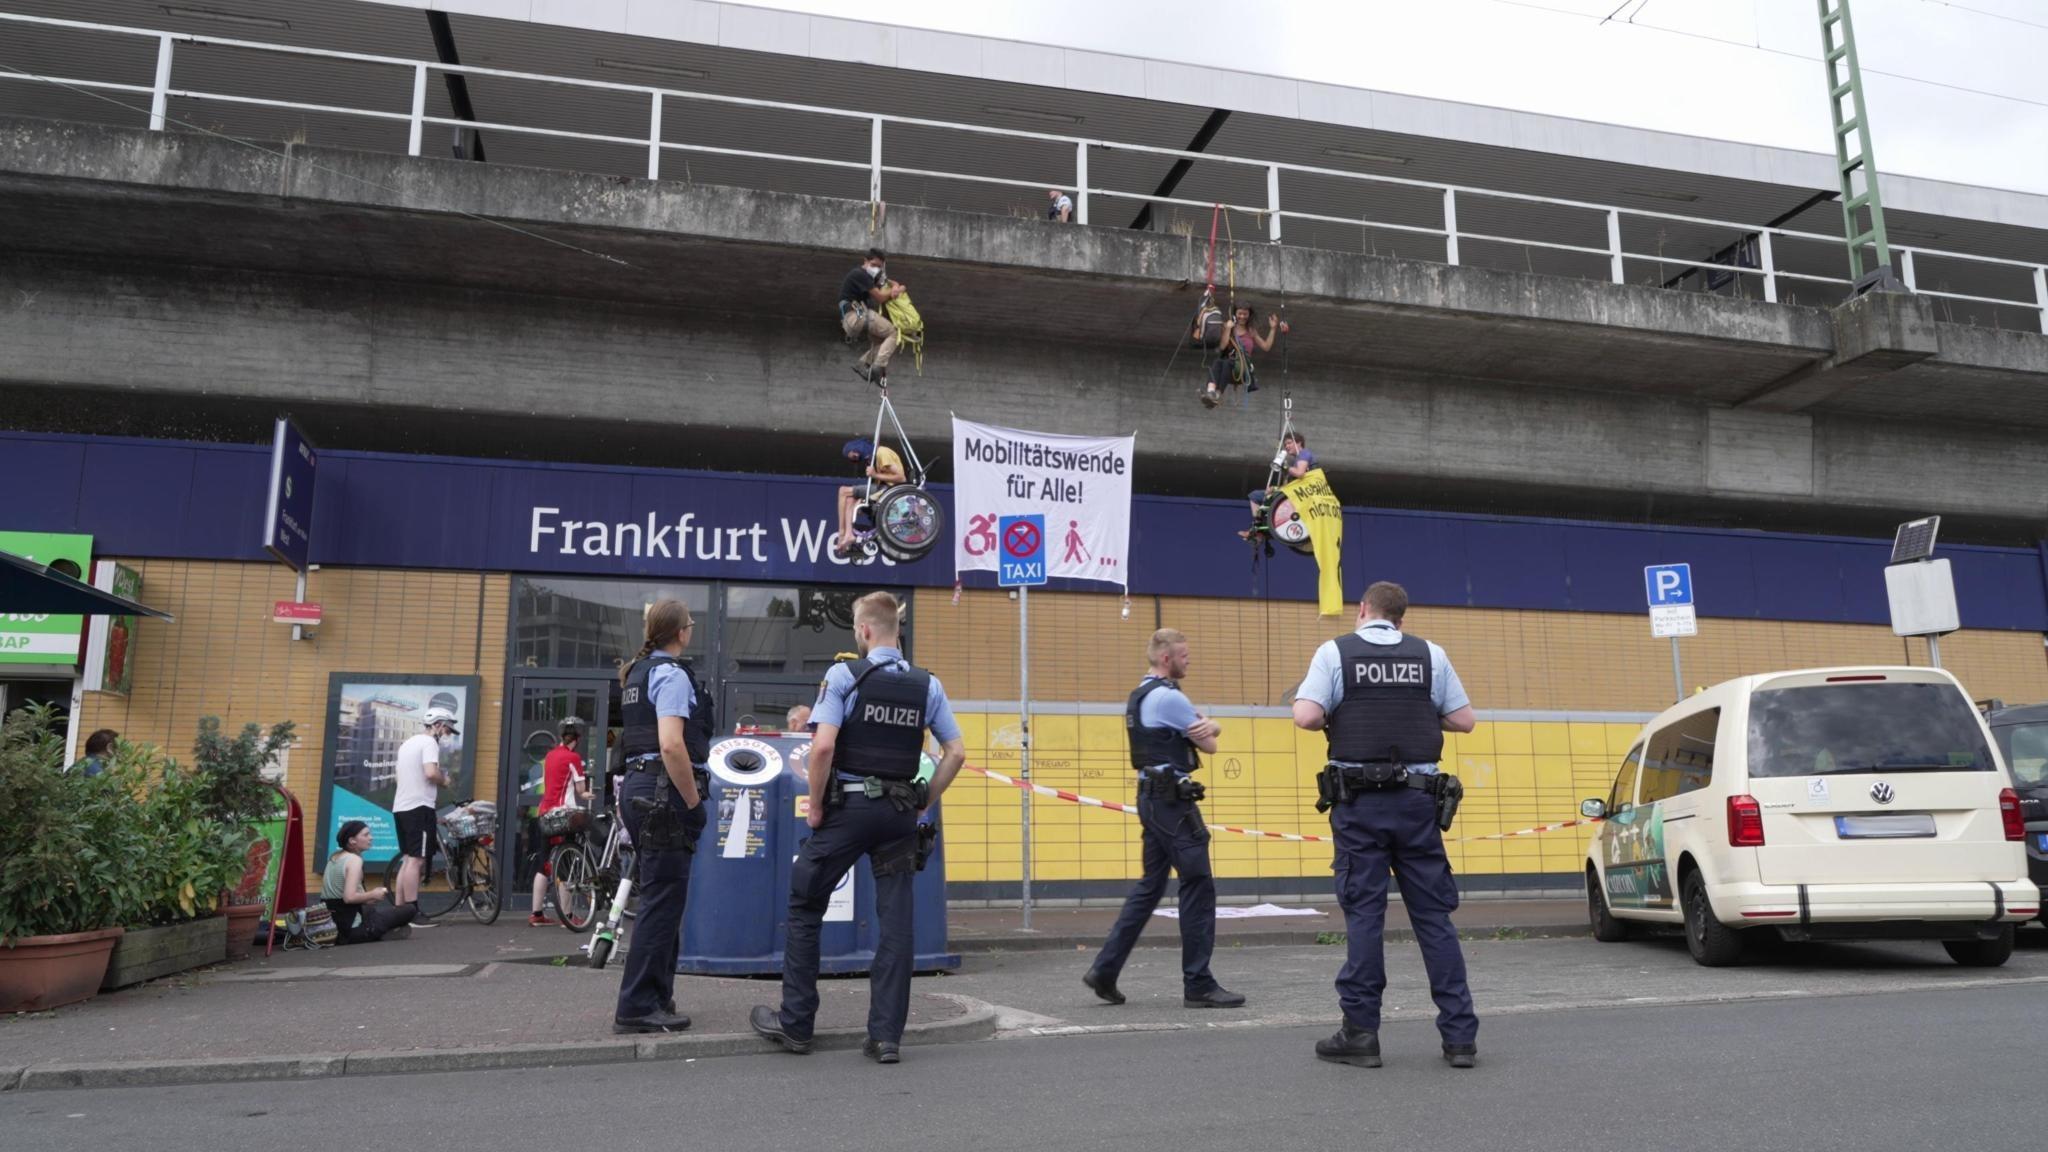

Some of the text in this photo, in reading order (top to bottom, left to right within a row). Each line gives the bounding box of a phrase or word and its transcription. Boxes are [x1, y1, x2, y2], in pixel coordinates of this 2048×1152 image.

[965, 438, 1125, 475] Mobilitätswende
[1007, 474, 1083, 504] für Alle!
[530, 507, 897, 567] Frankfurt We
[1003, 562, 1042, 579] TAXI
[1656, 570, 1680, 601] P
[1355, 663, 1424, 683] POLIZEI
[863, 704, 920, 727] POLIZEI
